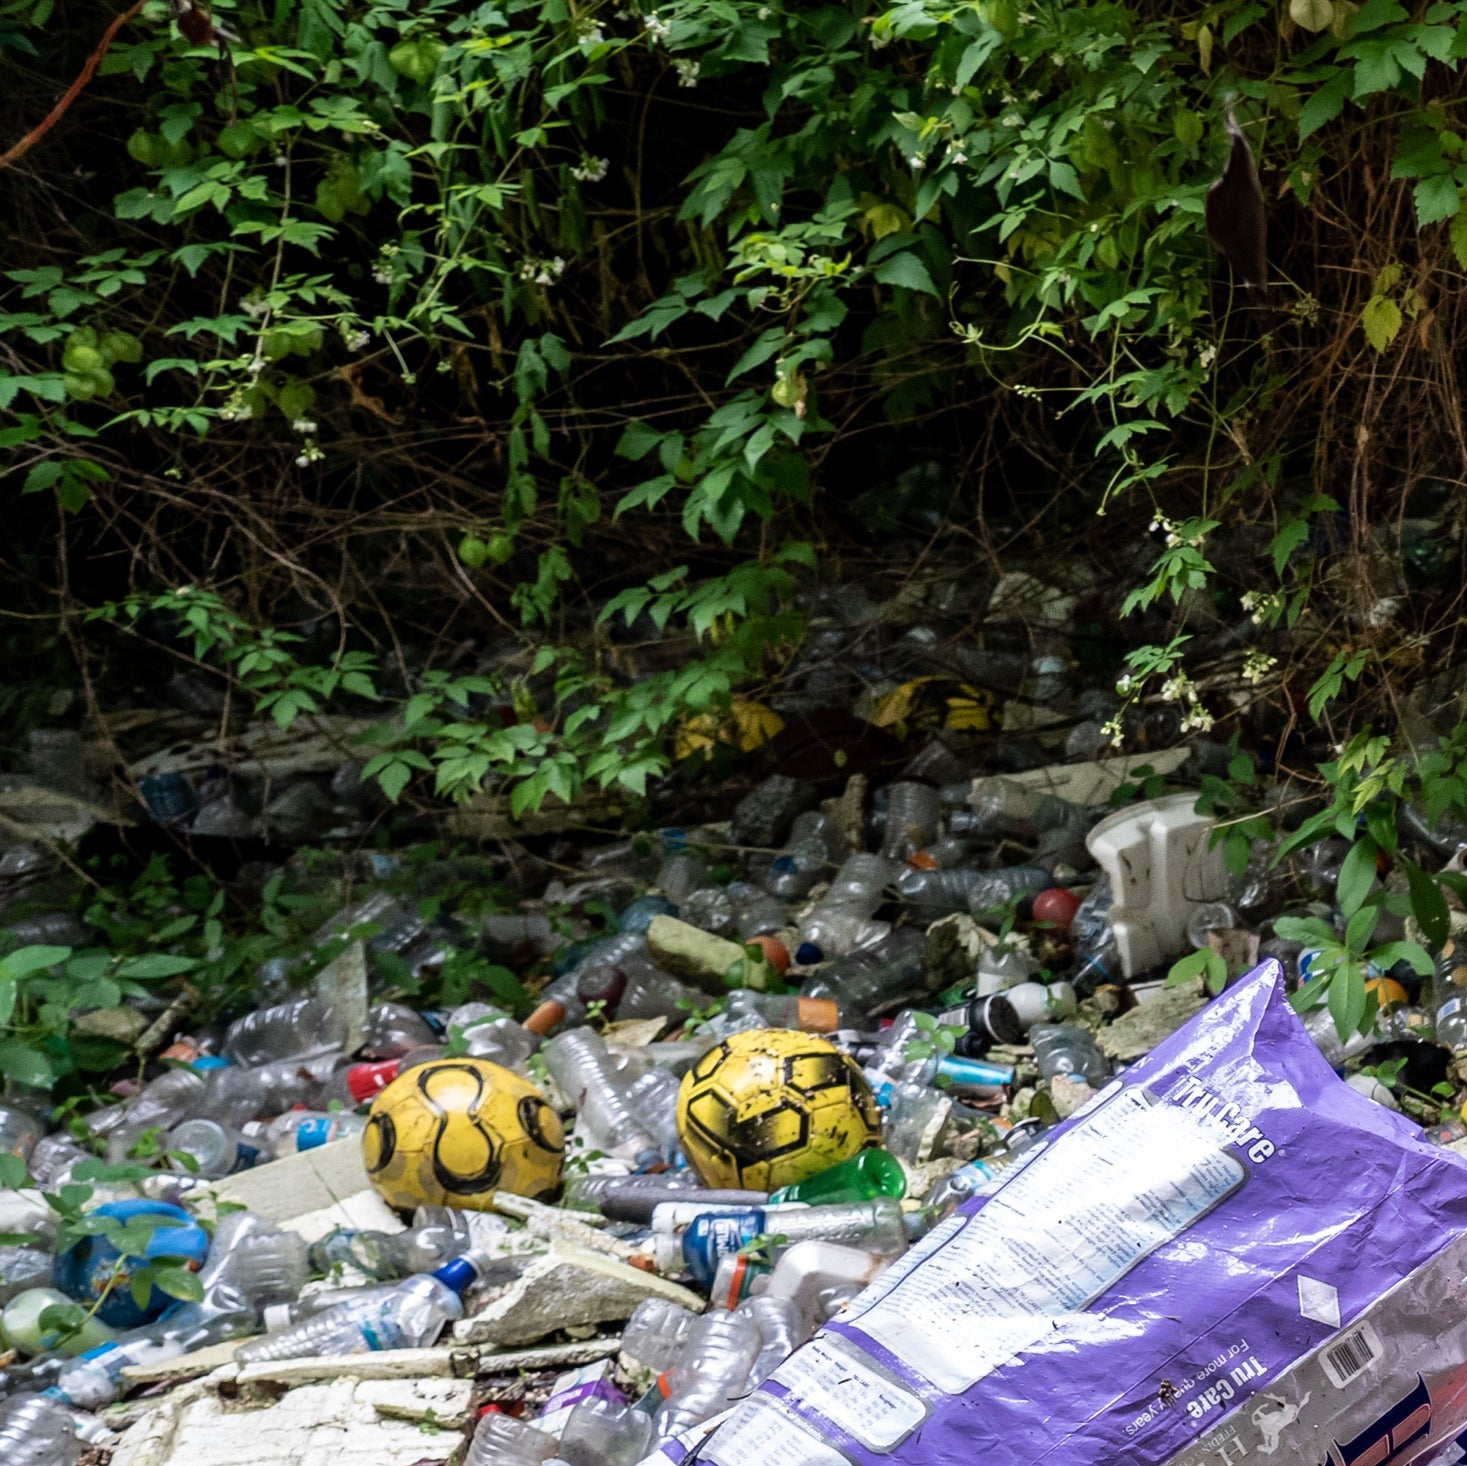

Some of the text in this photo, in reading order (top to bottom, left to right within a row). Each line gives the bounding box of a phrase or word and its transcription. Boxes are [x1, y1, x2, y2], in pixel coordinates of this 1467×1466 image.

[1212, 1101, 1277, 1164] Care
[1194, 1355, 1227, 1381] more
[1227, 1339, 1250, 1361] For
[1187, 1355, 1268, 1419] Tru Care
